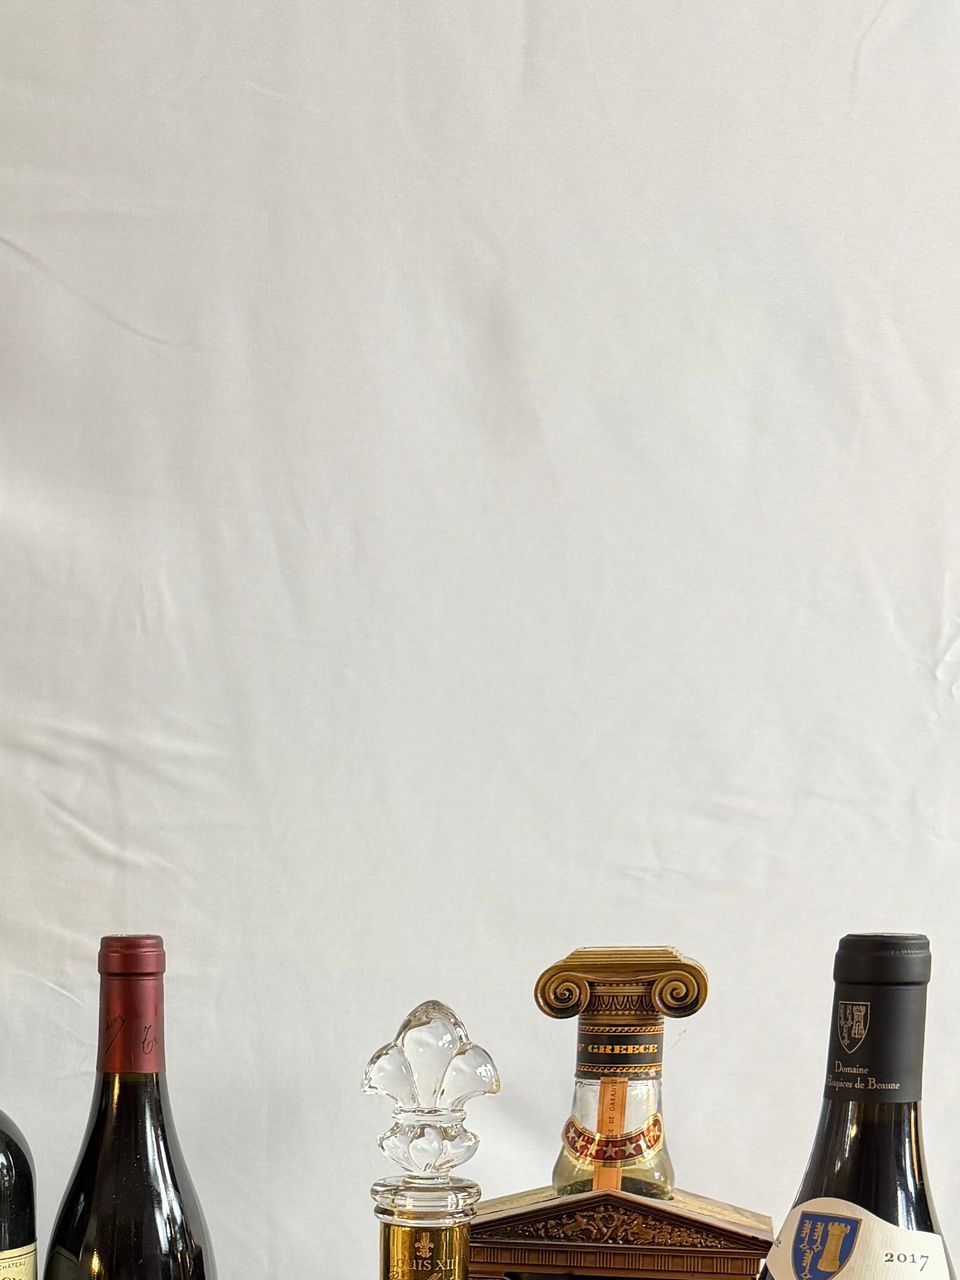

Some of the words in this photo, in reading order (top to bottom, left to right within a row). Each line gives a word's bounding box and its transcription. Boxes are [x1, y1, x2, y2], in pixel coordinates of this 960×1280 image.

[588, 1044, 658, 1054] GREECE
[835, 1060, 869, 1075] Domaine
[854, 1077, 865, 1089] de
[867, 1077, 901, 1090] Beaune
[884, 1252, 929, 1272] 2017
